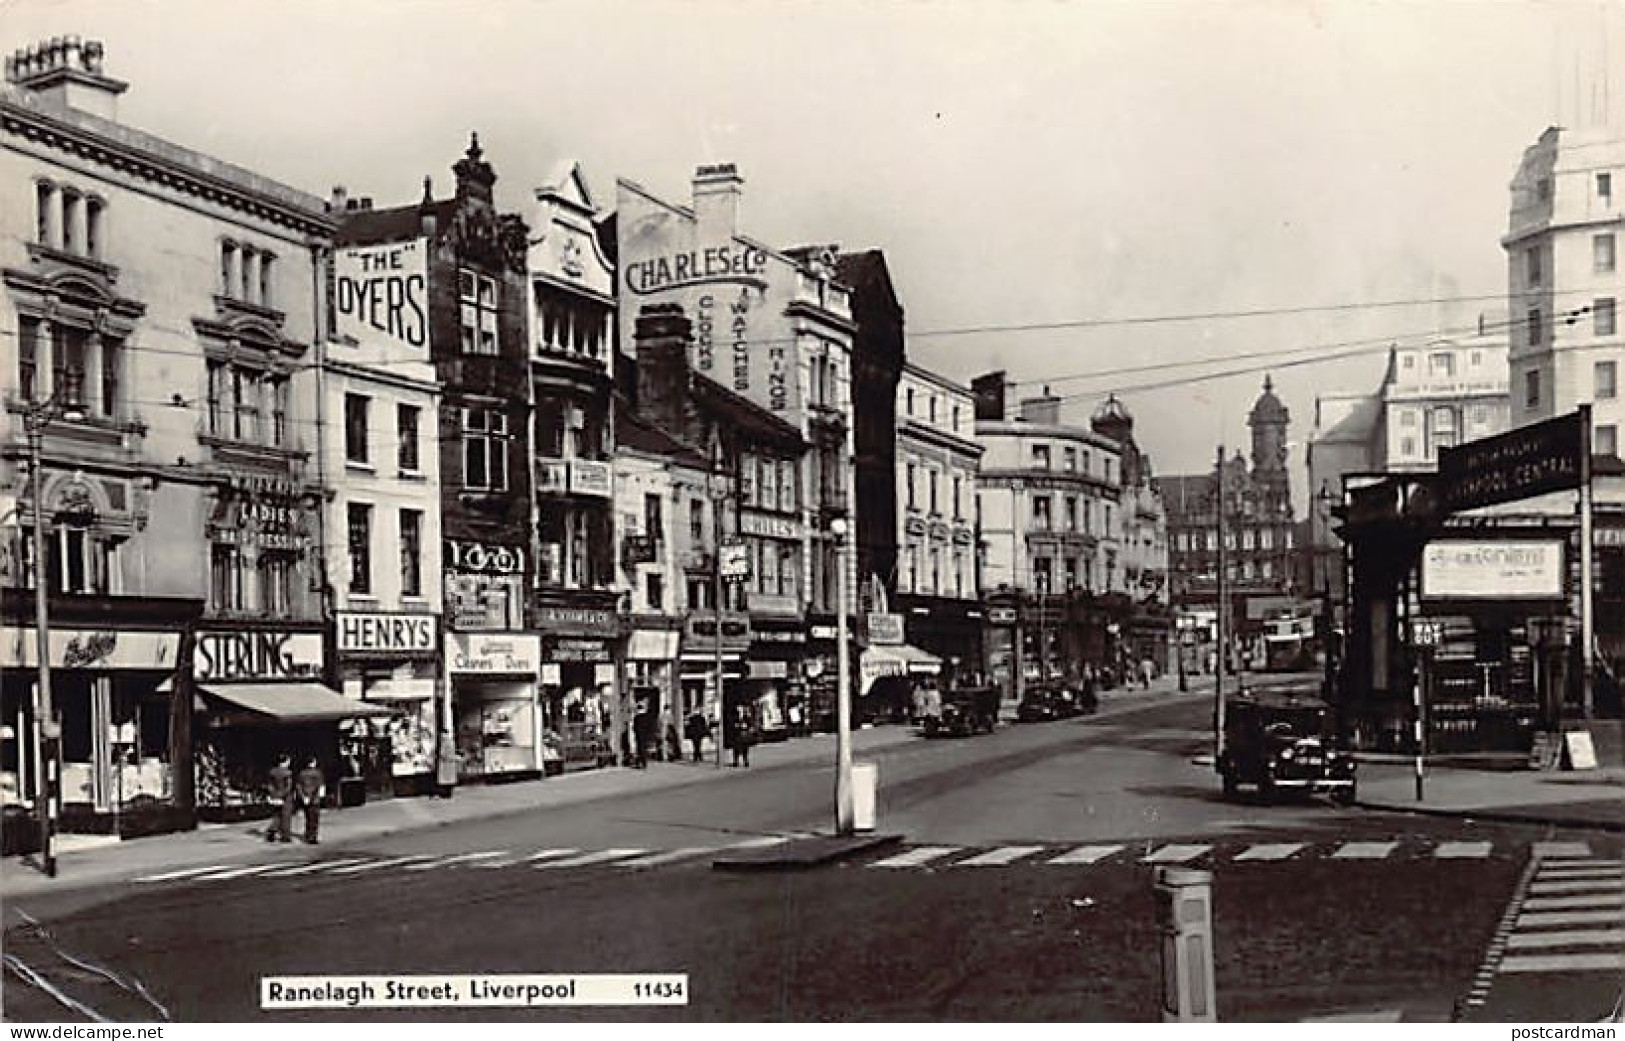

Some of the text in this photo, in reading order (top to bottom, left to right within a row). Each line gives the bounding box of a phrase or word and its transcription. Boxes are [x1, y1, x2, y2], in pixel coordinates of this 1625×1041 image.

[625, 247, 730, 294] CHARLES
[338, 274, 426, 347] DYERS
[699, 295, 714, 371] CLOCKS
[769, 347, 787, 411] RINGS
[241, 502, 298, 524] LADIES
[342, 616, 431, 648] HENRYS
[1413, 623, 1440, 634] WAY
[1413, 633, 1441, 645] OUT
[198, 632, 295, 680] STERLING
